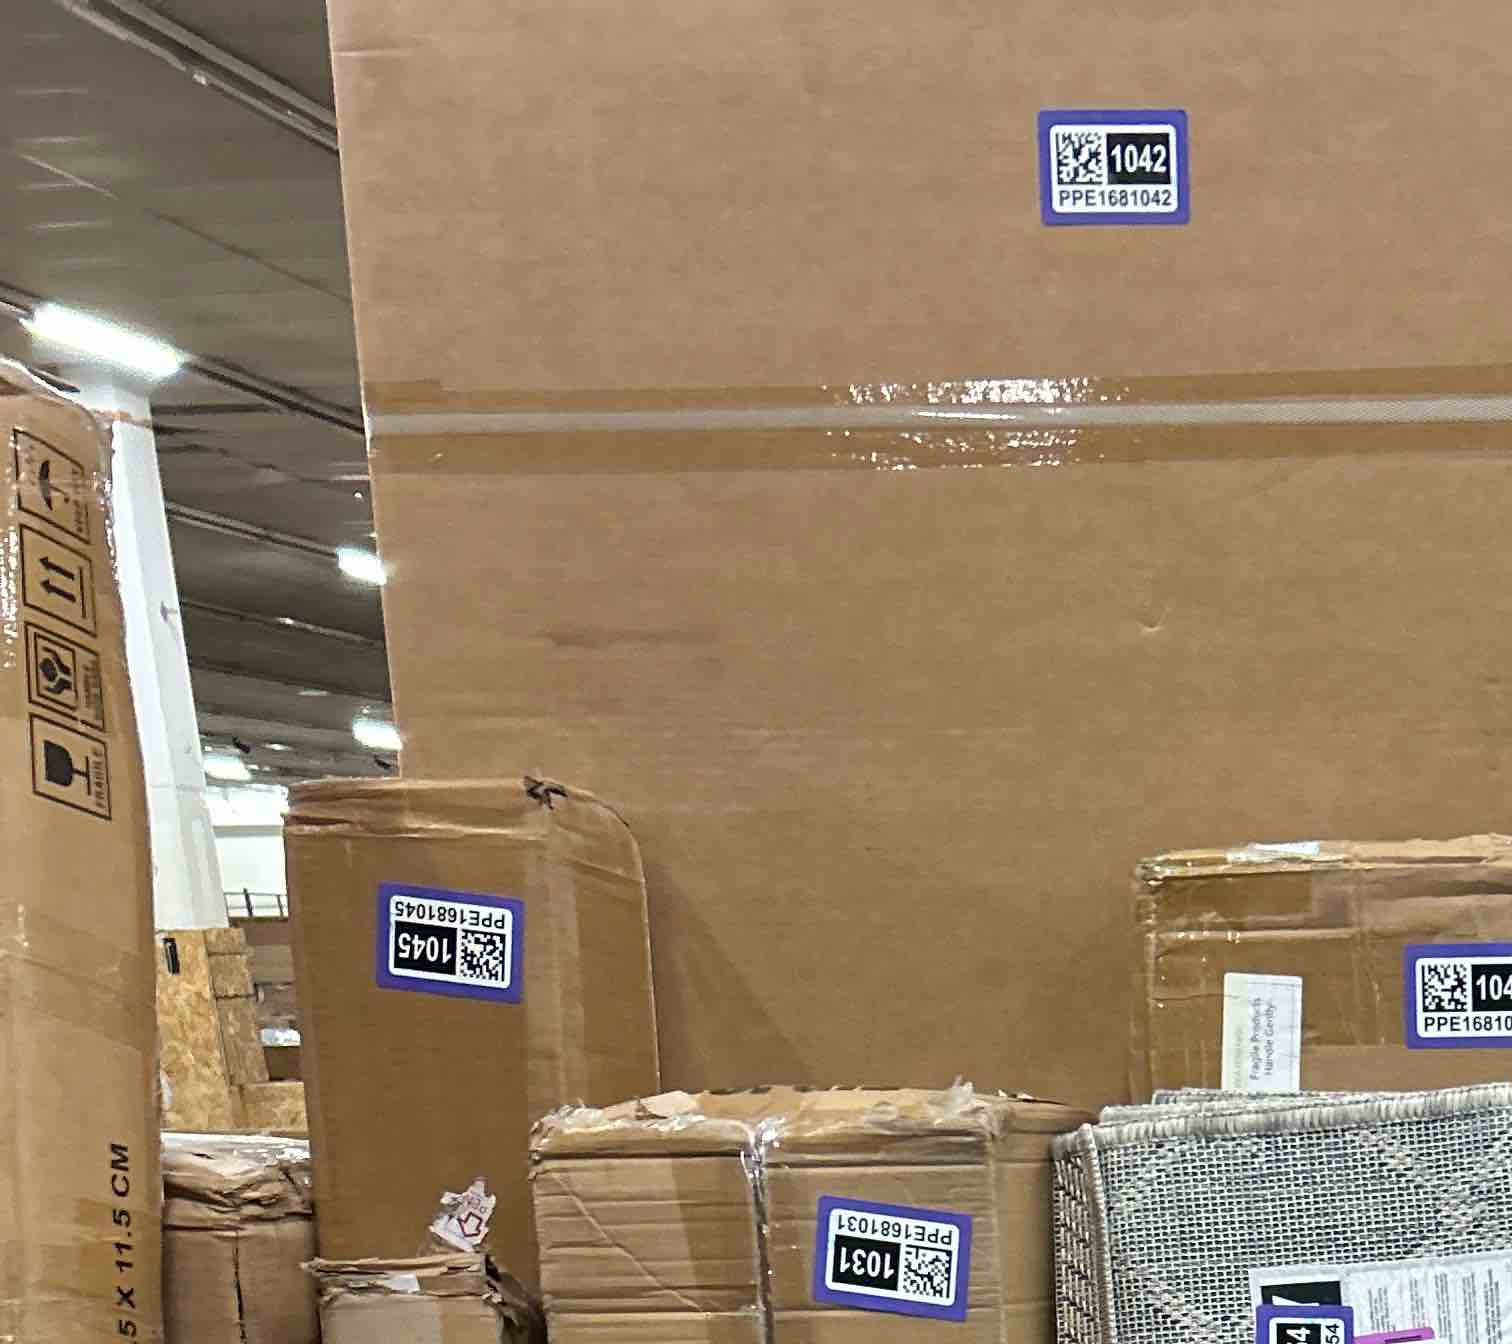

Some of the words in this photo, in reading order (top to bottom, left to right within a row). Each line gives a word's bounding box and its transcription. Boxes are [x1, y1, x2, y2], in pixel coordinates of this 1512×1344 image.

[1110, 143, 1168, 173] 1042
[1059, 190, 1172, 206] PPE1681042
[395, 900, 505, 930] PPE1681045
[398, 932, 452, 964] 1045
[109, 1142, 131, 1198] CM
[112, 1208, 133, 1274] 11.5
[838, 1214, 953, 1246] PPE1681031
[839, 1246, 895, 1280] 1031
[116, 1285, 136, 1310] X
